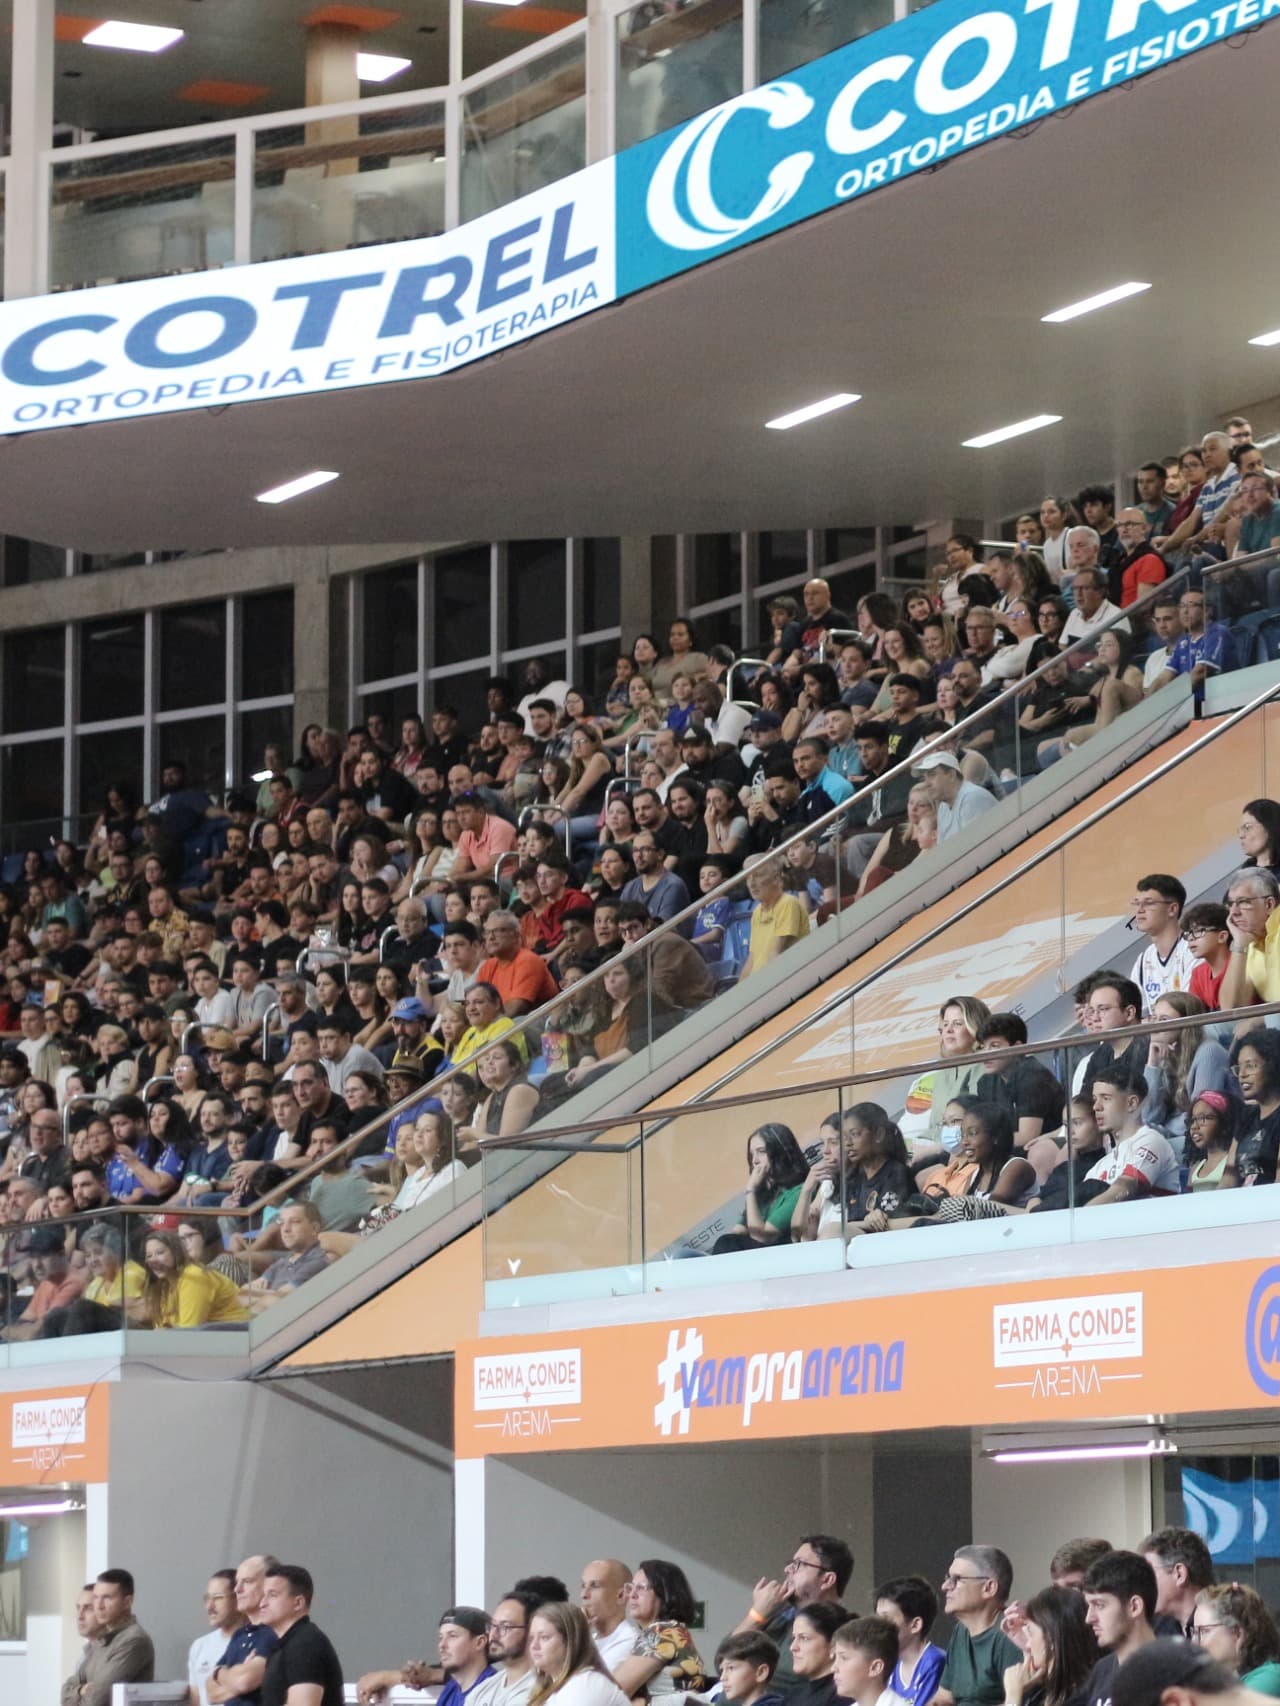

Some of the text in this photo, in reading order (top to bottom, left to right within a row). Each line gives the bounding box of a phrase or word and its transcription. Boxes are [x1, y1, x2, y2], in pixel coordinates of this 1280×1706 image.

[835, 86, 1055, 199] ORTOPEDIA
[1065, 66, 1093, 101] E
[1, 201, 599, 387] COTREL
[13, 281, 599, 423] ORTOPEDIA E FISIOTERAPIA
[1000, 1306, 1136, 1344] FARMA CONDE
[478, 1360, 576, 1390] FARMA CONDE
[1032, 1364, 1101, 1398] ARENA
[15, 1407, 82, 1430] FARMA CONDE
[502, 1409, 552, 1437] ARENA
